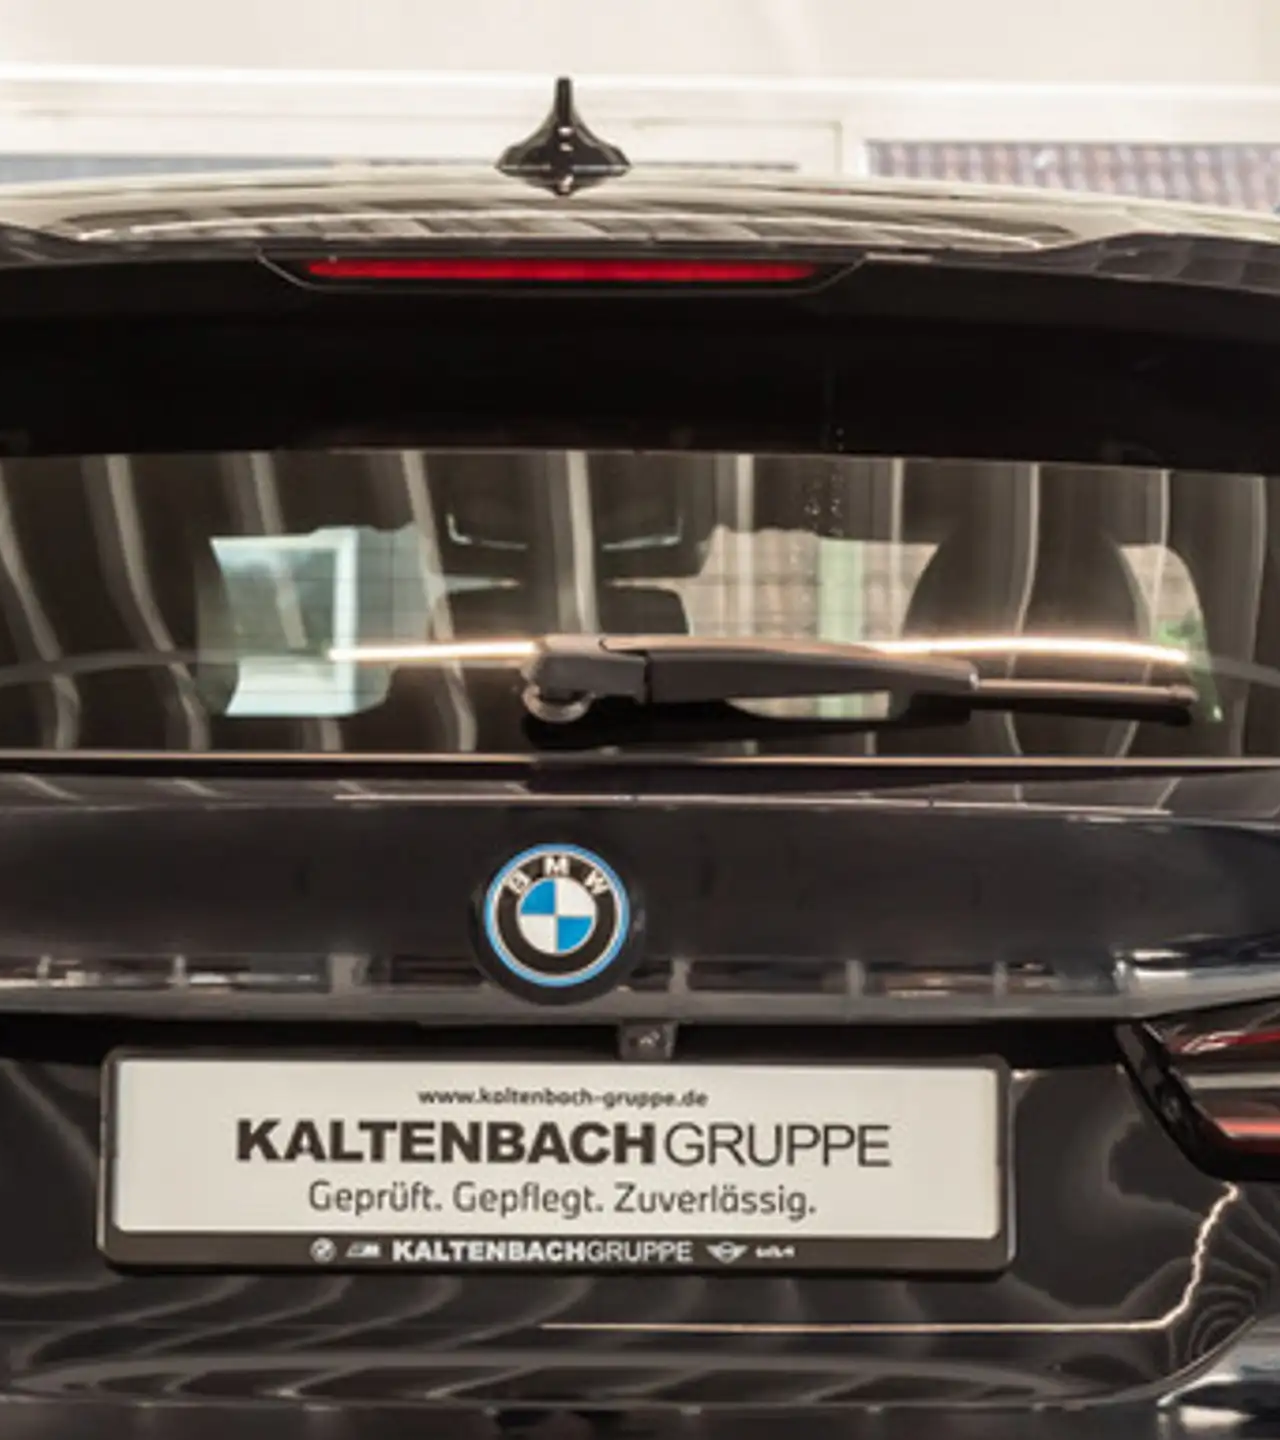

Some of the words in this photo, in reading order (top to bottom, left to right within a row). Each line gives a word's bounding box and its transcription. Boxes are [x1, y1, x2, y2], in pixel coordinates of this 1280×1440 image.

[504, 855, 609, 895] BMW
[417, 1087, 709, 1108] www.kaltenbach-gruppe.de
[308, 1179, 443, 1216] Geprüft.
[452, 1180, 604, 1220] Gepflegt.
[613, 1182, 817, 1222] Zuverlässig.
